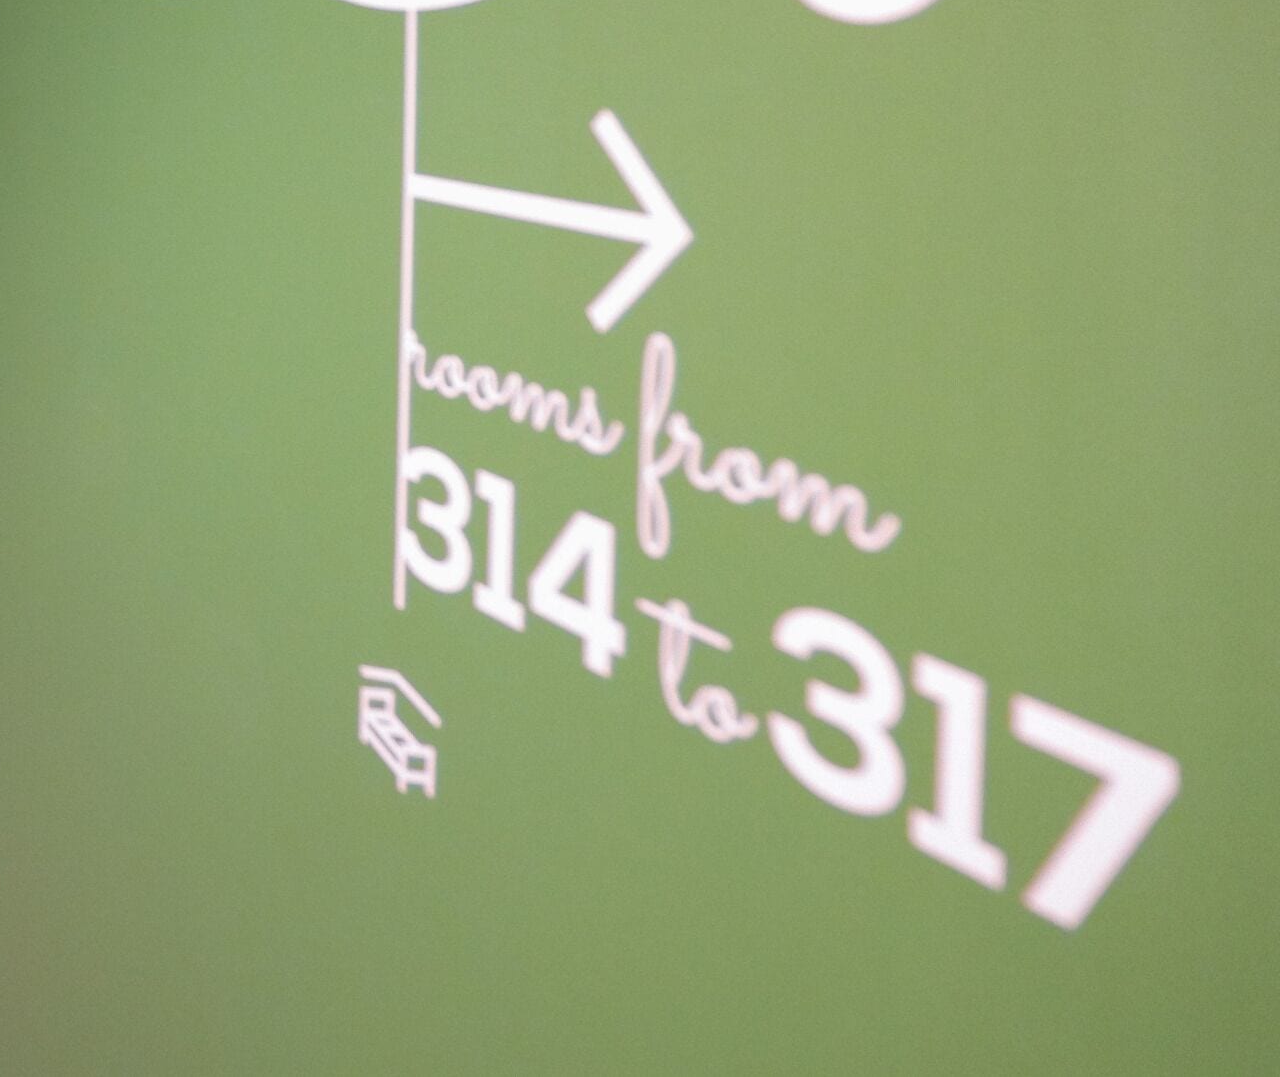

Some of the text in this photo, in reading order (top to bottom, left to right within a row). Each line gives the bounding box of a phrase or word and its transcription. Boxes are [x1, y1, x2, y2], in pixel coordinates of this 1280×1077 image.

[402, 330, 900, 559] rooms from
[401, 446, 1181, 931] 314 to 317
